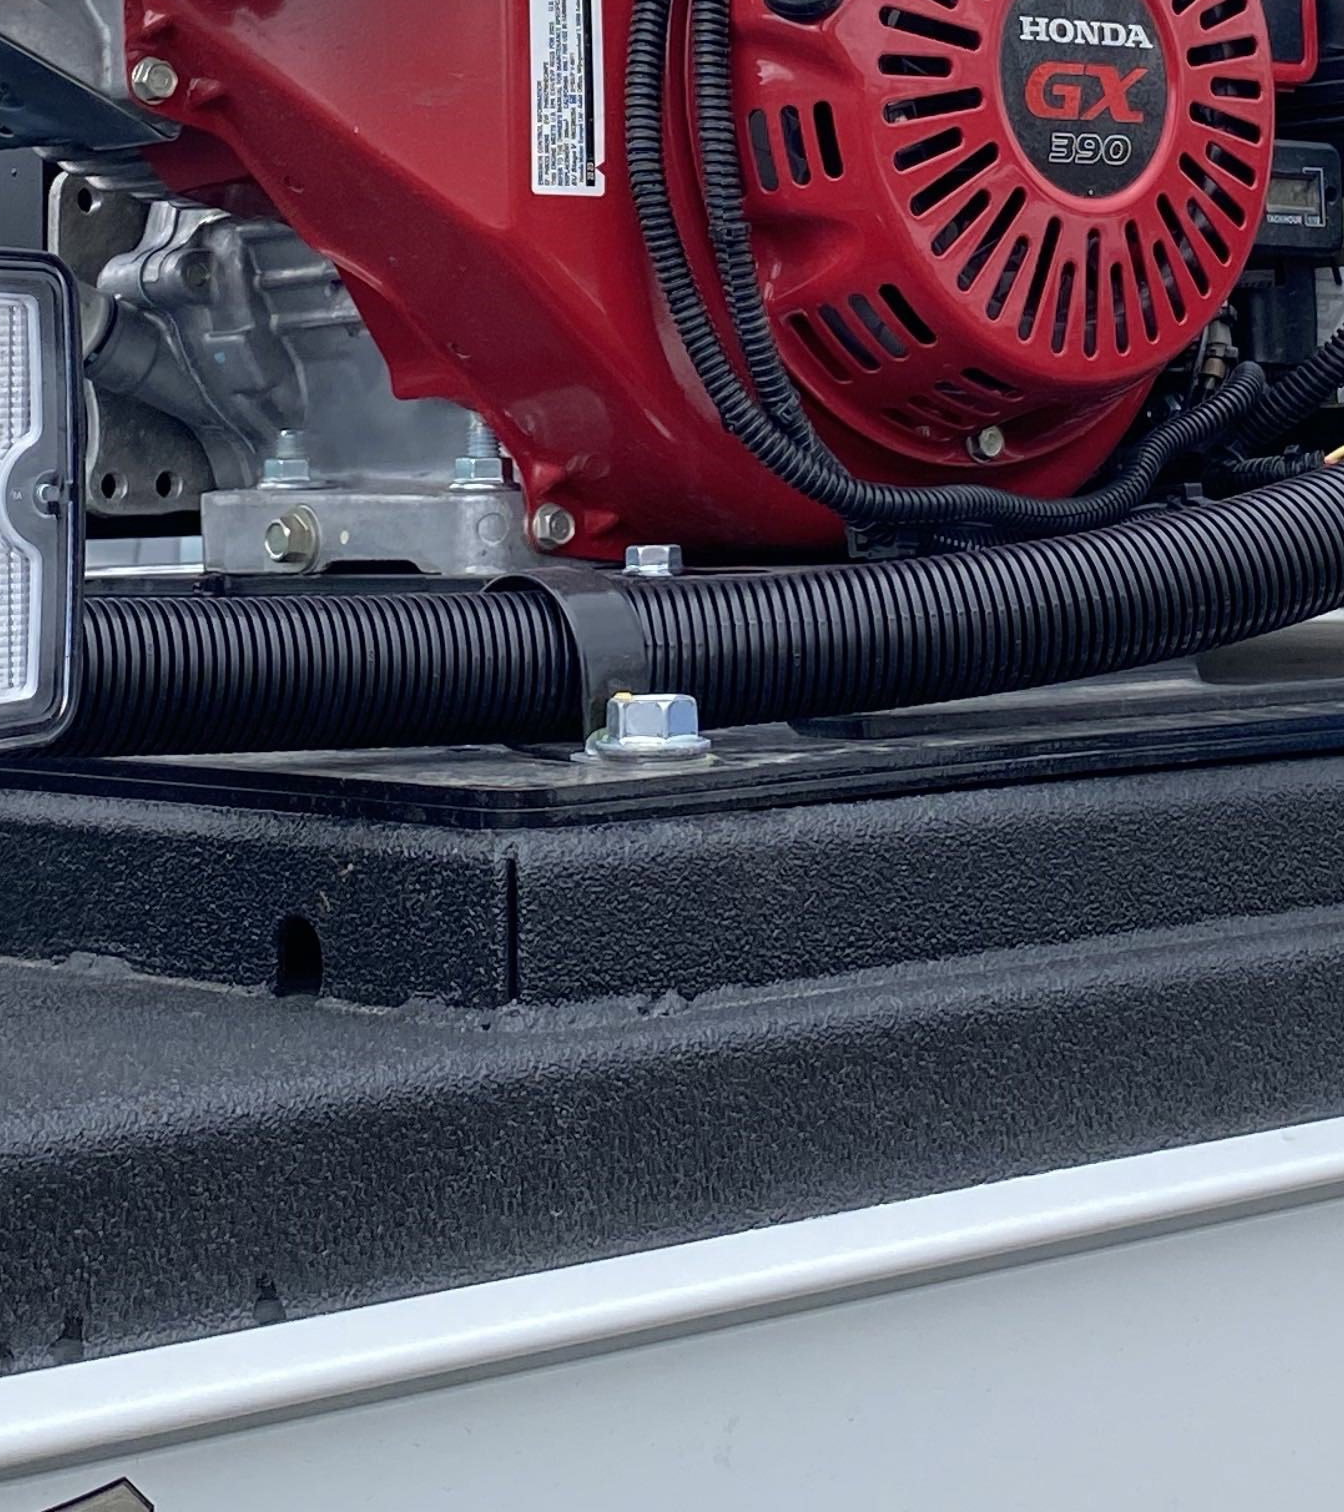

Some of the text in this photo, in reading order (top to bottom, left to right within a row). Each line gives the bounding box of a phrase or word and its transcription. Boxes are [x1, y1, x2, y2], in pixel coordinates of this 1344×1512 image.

[1019, 16, 1154, 49] HONDA
[1025, 60, 1149, 123] GX
[1049, 132, 1132, 165] 390
